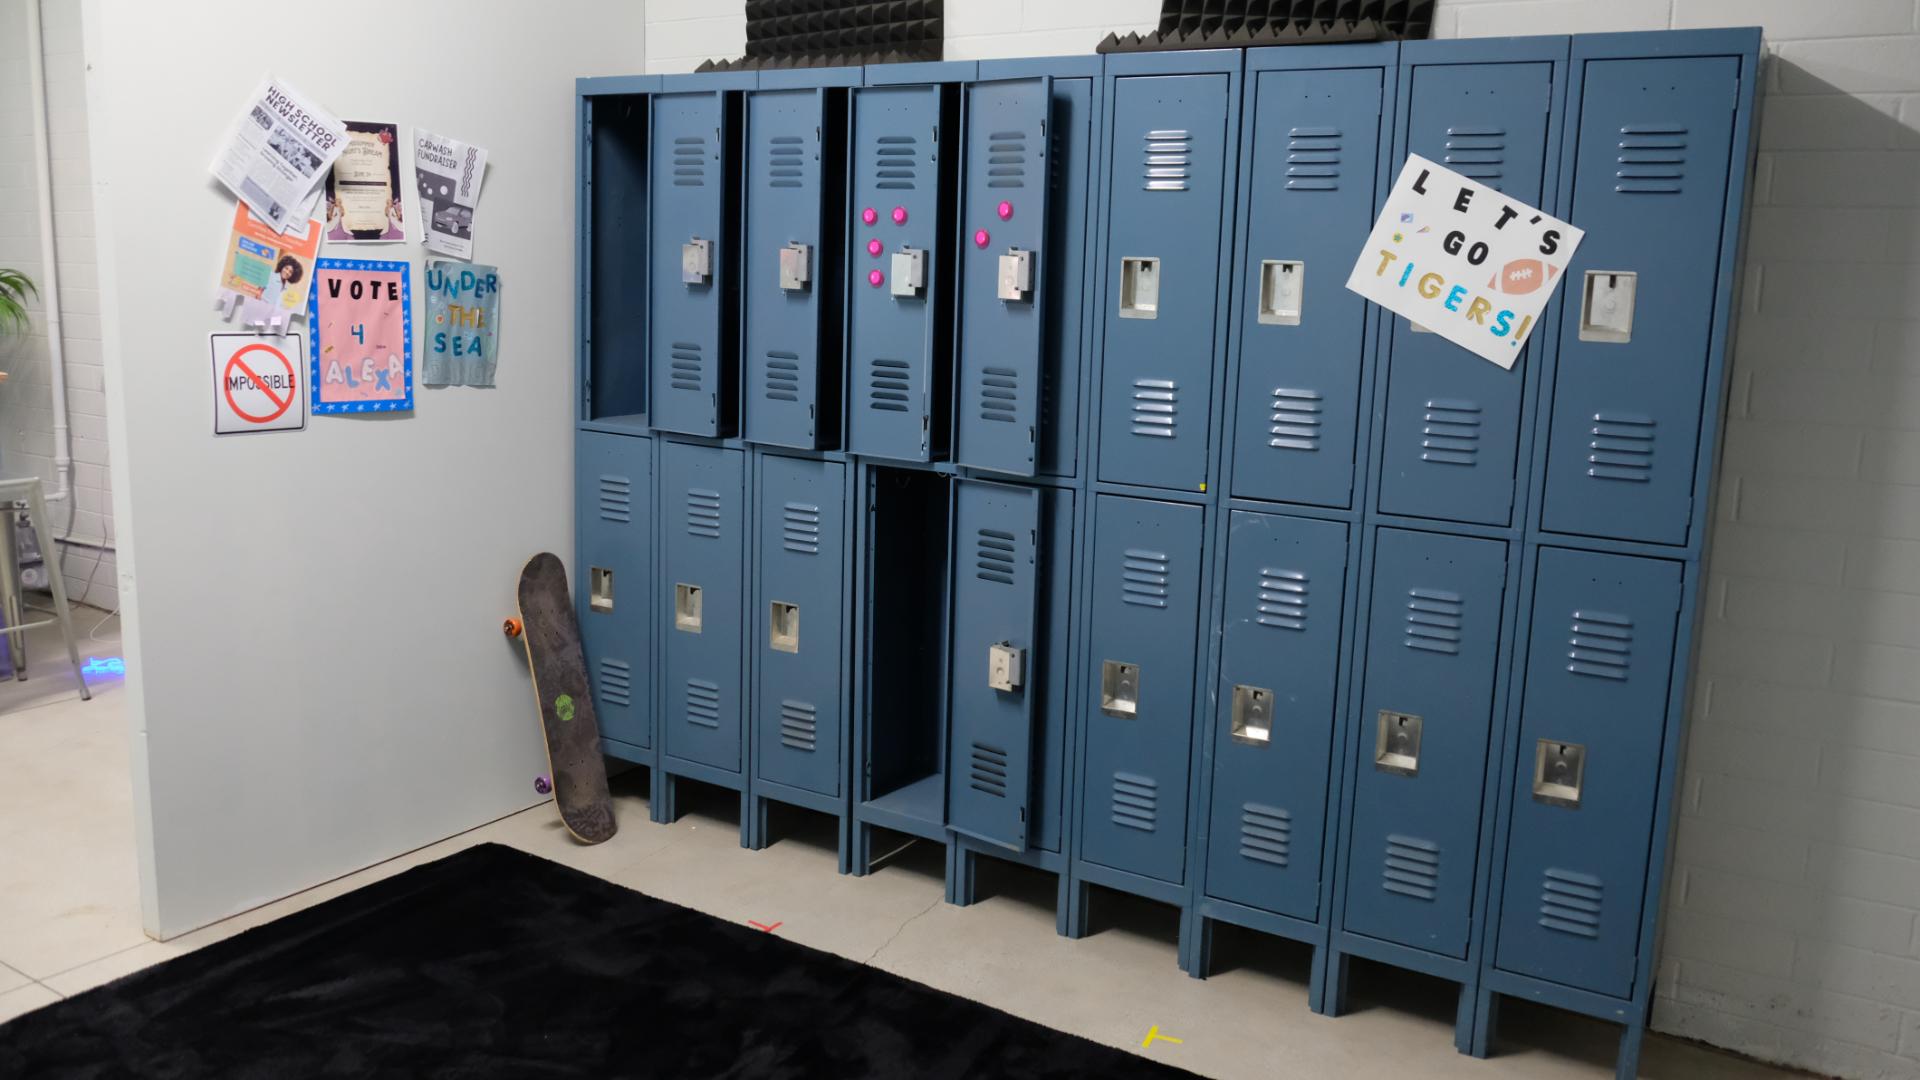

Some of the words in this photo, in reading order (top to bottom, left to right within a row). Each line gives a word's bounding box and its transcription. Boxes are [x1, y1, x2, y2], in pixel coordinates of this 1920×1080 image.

[265, 94, 331, 152] NEWSLETTER
[267, 86, 295, 111] HIGH
[295, 109, 337, 147] SCHOOL
[417, 149, 458, 169] FUNDRAISER
[418, 138, 453, 157] CARWASH
[1412, 169, 1561, 256] LET'S
[1443, 230, 1489, 266] GO
[328, 278, 398, 301] VOTE
[427, 269, 497, 299] UNDER
[1375, 249, 1533, 347] TIGERS!
[448, 303, 487, 329] THE
[351, 323, 364, 345] 4
[434, 332, 482, 357] SEA
[325, 352, 403, 391] ALEXA
